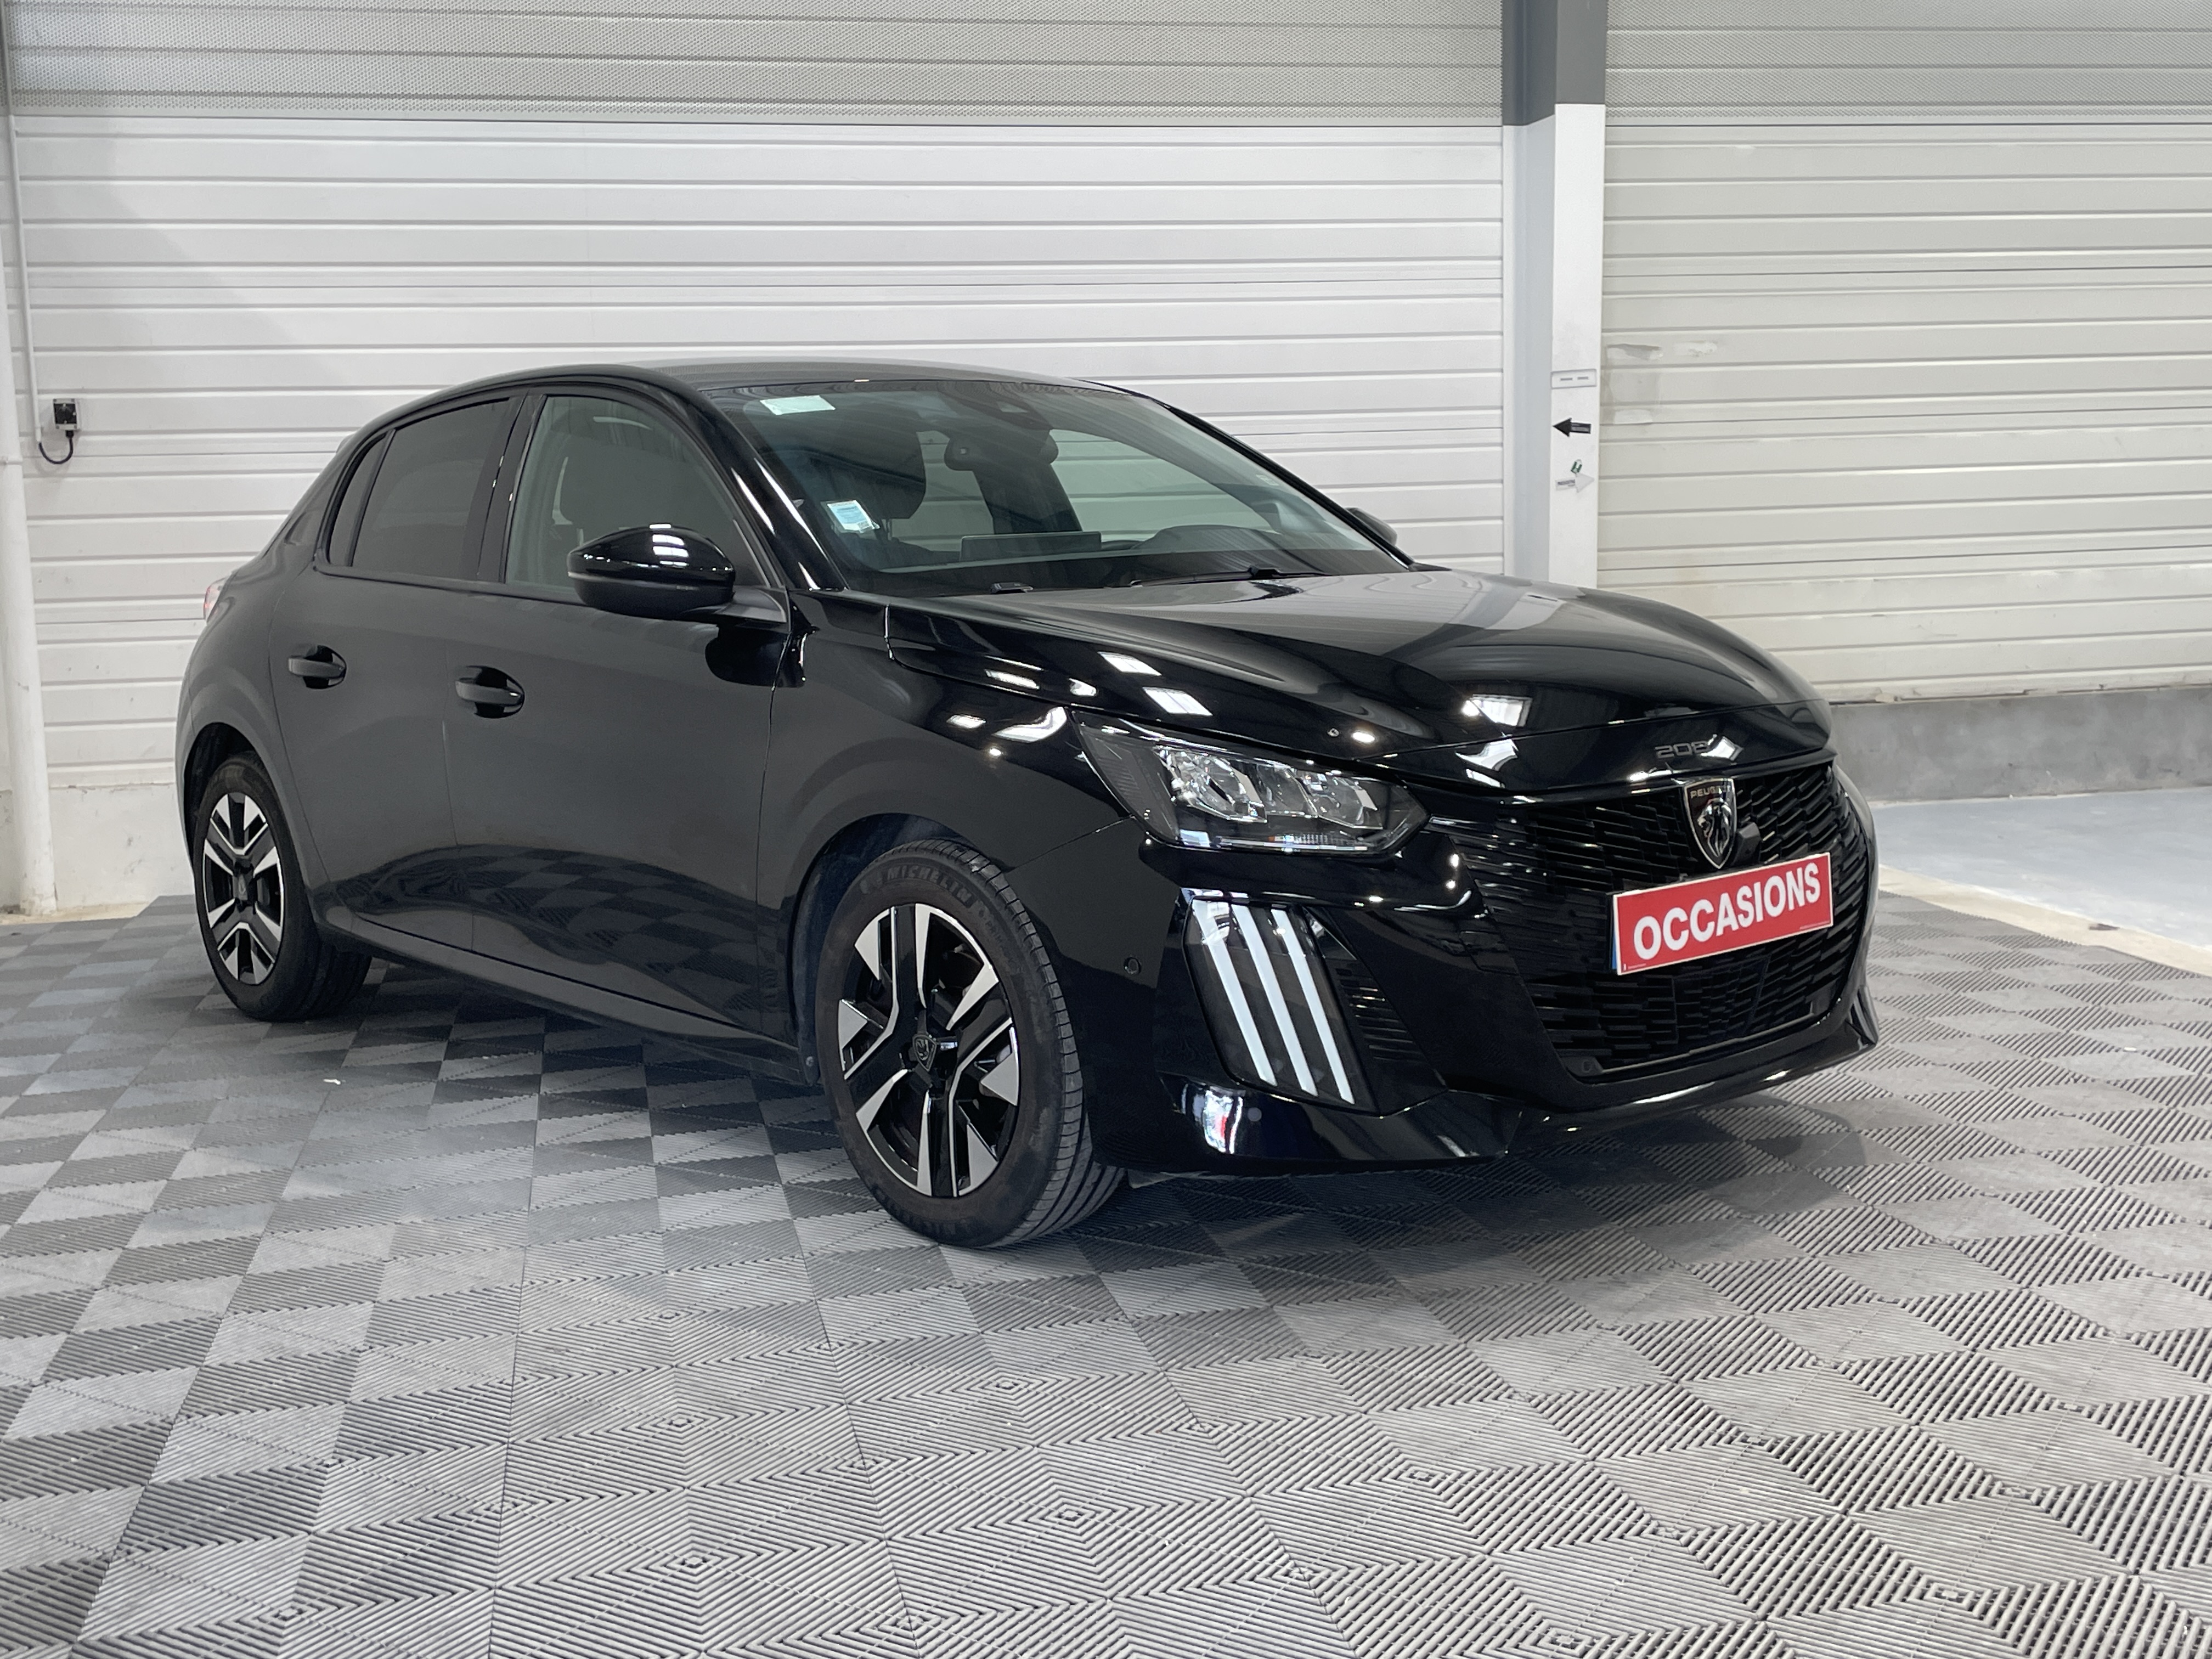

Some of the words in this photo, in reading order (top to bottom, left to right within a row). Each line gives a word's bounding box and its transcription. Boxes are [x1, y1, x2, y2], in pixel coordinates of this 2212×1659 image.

[1654, 740, 1710, 759] 208
[887, 865, 973, 903] MICHELIN
[1633, 862, 1821, 960] OCCASIONS
